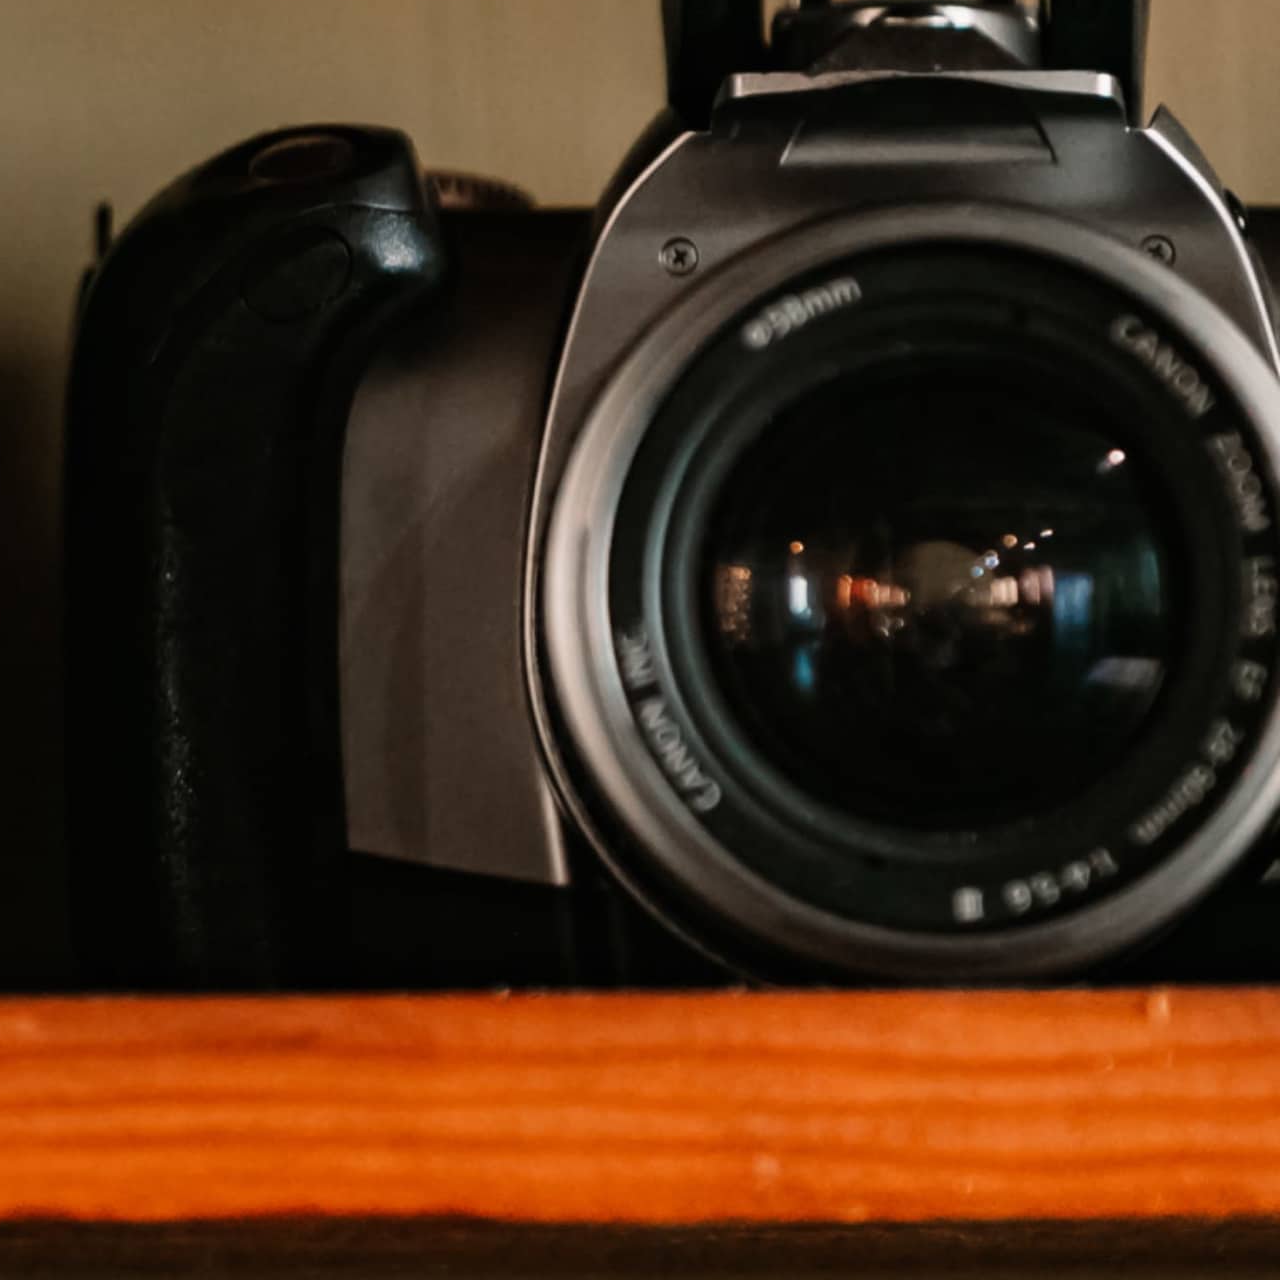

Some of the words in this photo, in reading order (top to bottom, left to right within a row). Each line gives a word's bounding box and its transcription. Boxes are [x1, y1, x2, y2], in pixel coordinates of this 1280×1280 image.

[1110, 314, 1216, 418] CANON
[1205, 430, 1270, 532] ZOOM
[641, 696, 722, 812] CANON
